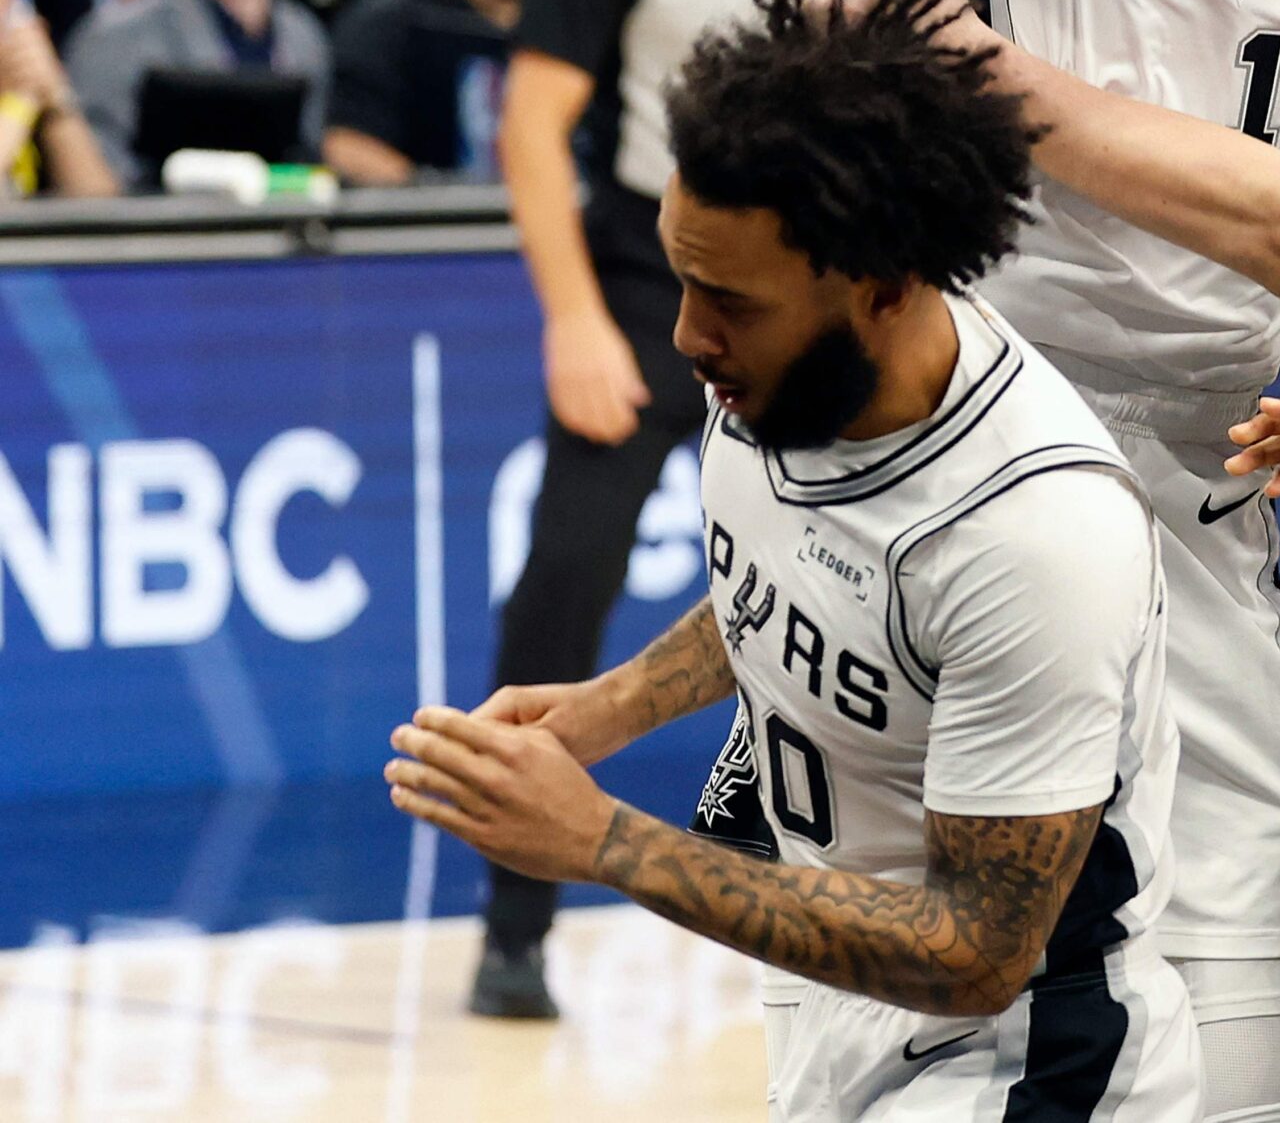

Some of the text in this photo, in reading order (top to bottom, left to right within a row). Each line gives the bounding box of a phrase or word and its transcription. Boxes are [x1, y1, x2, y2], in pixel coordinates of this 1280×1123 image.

[0, 427, 371, 651] NBC
[703, 510, 889, 732] PURS
[809, 541, 863, 586] LEDGER
